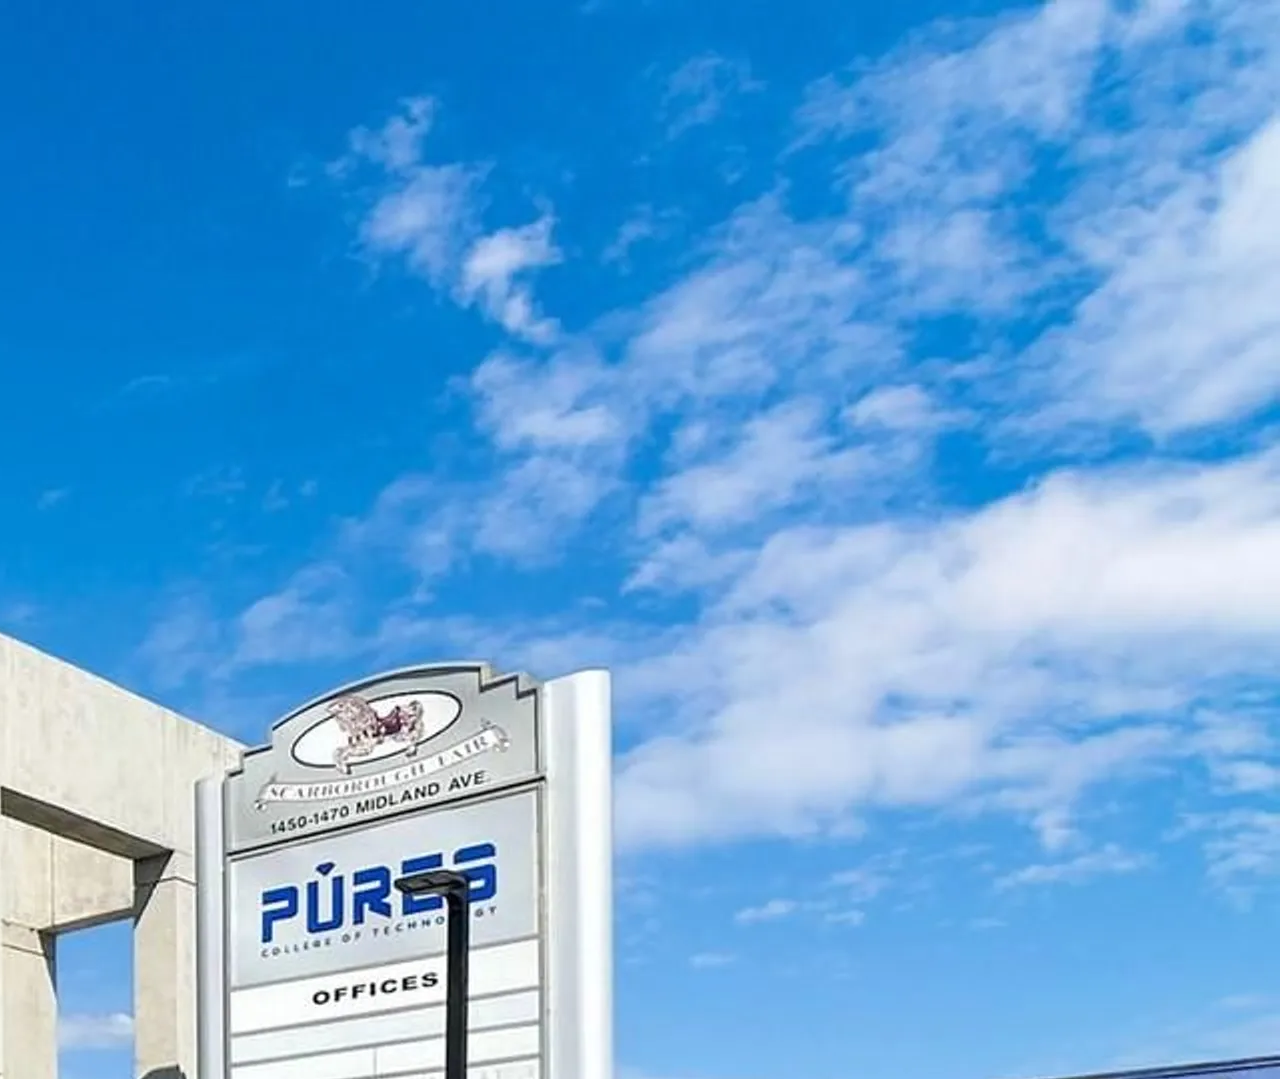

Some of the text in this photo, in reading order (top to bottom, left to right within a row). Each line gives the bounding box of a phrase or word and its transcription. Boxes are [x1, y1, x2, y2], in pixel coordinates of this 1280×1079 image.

[271, 805, 350, 834] 1450-1470
[355, 782, 441, 815] MIDLAND
[261, 905, 498, 958] COLLEGE OF TECHNOGY
[312, 972, 439, 1005] OFFICES
